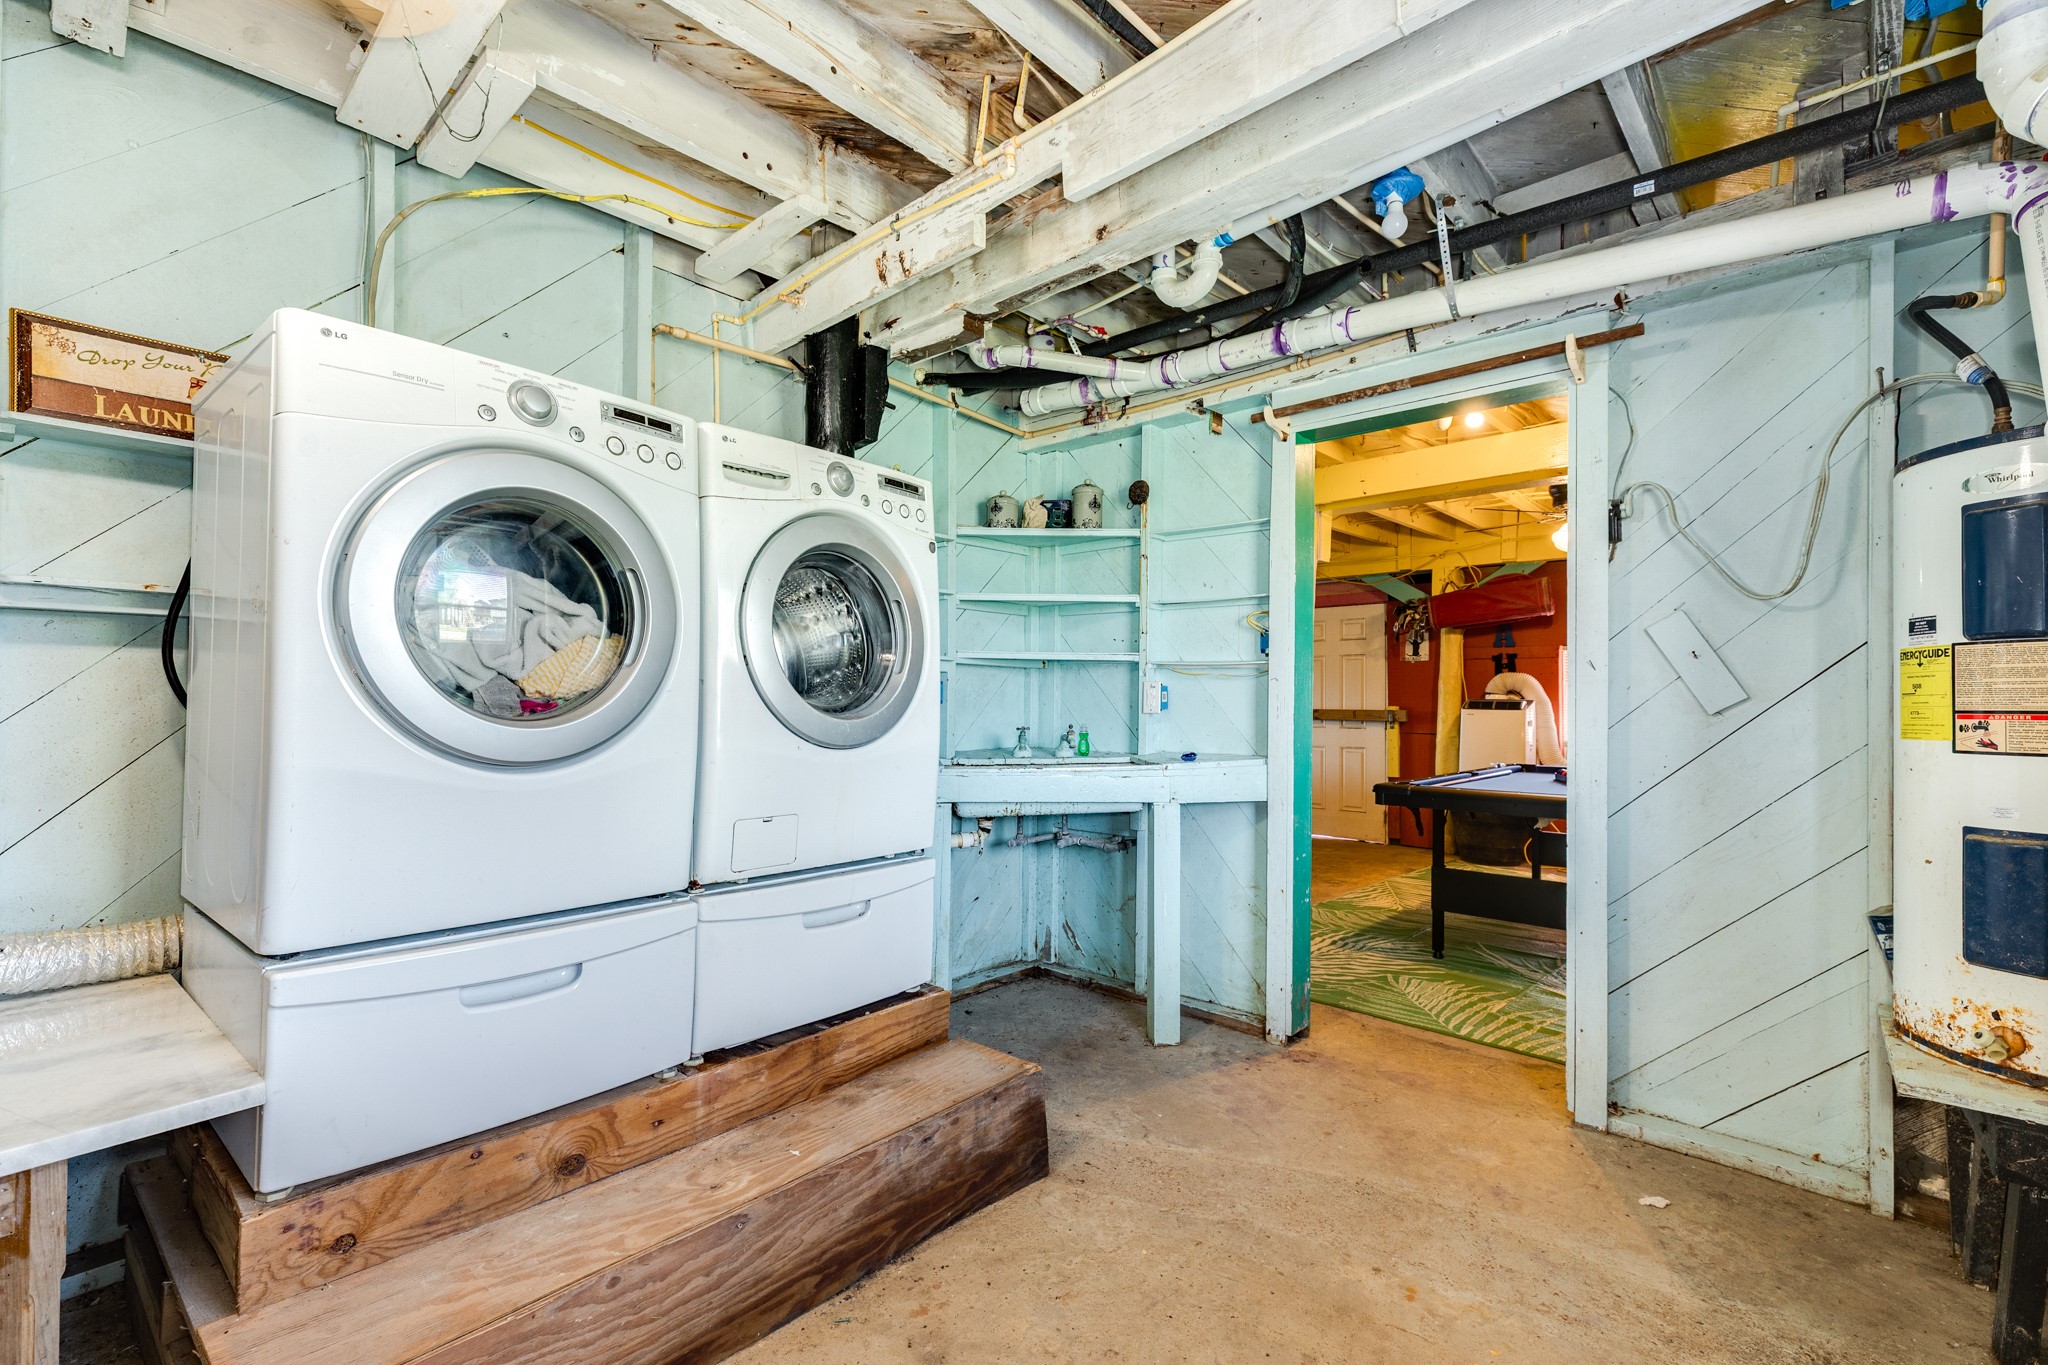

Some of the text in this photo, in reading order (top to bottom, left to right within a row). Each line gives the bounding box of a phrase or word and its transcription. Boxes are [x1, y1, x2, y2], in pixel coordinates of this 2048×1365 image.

[334, 331, 348, 340] LG
[77, 350, 136, 370] Drop
[142, 352, 195, 373] Your
[392, 370, 415, 381] Sensor
[416, 375, 429, 385] Dry
